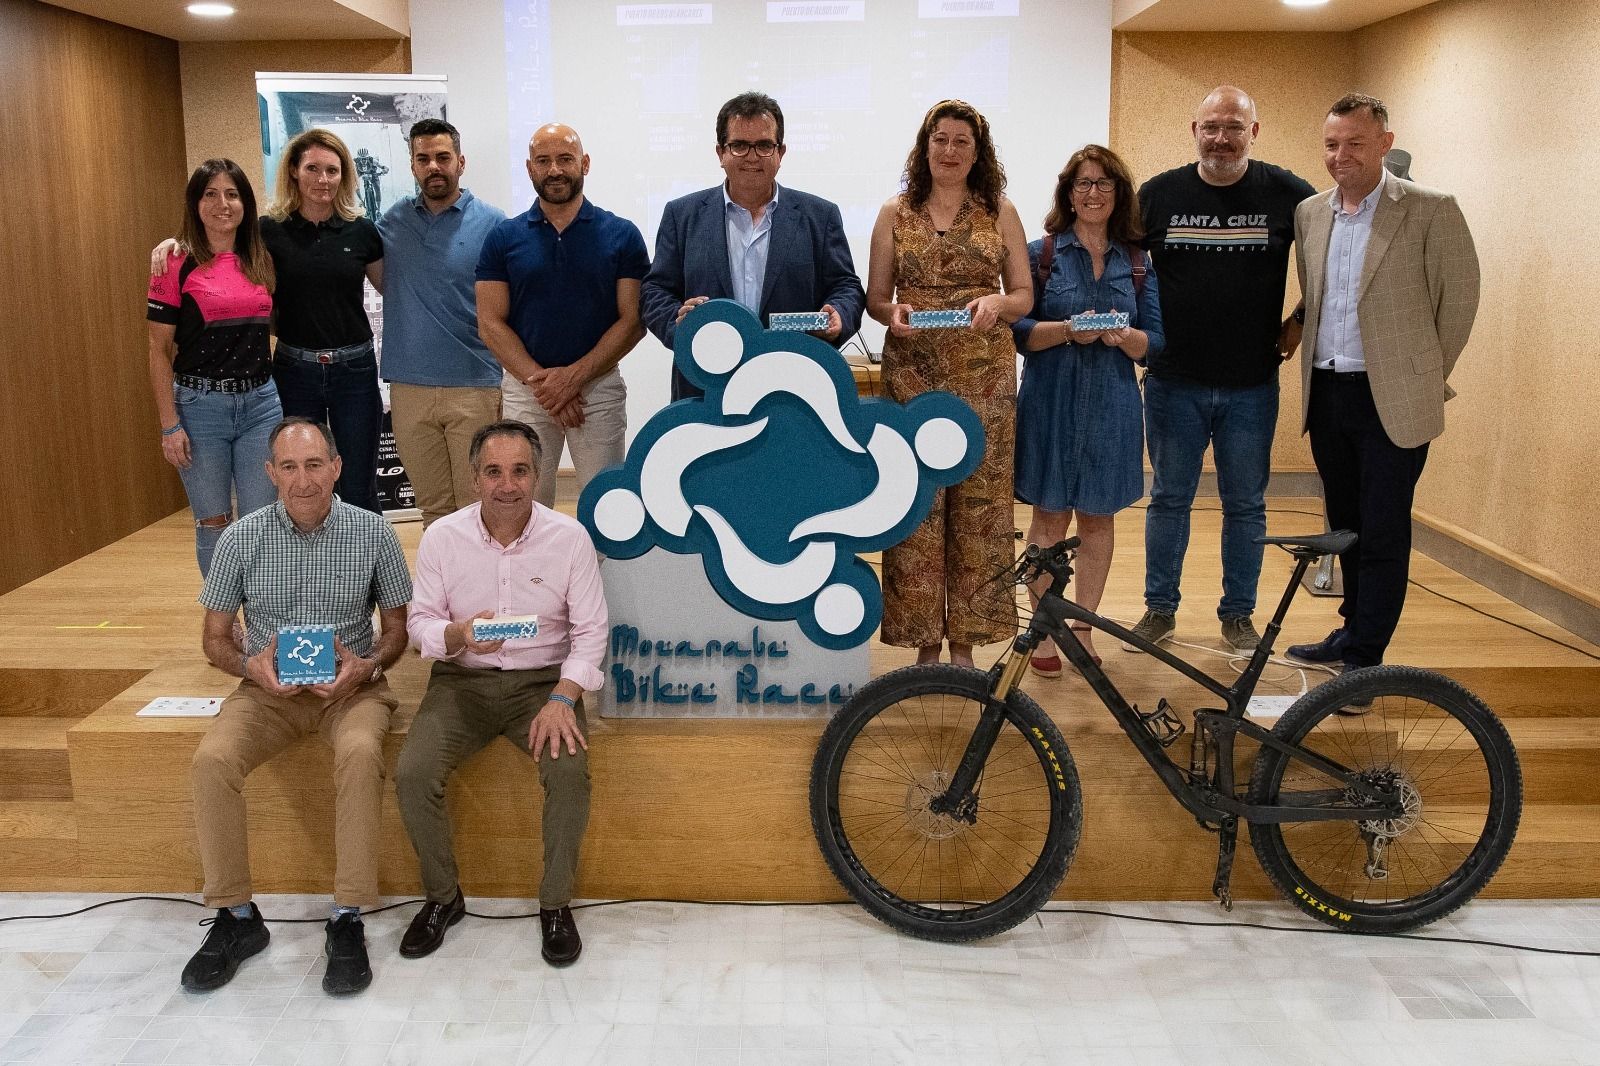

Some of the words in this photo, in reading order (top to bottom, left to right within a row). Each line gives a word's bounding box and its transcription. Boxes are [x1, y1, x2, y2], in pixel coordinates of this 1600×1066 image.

[1169, 214, 1221, 227] SANTA
[1227, 214, 1269, 227] CRUZ
[1164, 244, 1267, 252] CALIFORNIA
[611, 663, 718, 704] Bike
[736, 664, 853, 704] Race
[1031, 727, 1066, 791] MAXXIS
[1295, 887, 1352, 922] MAXXIS
